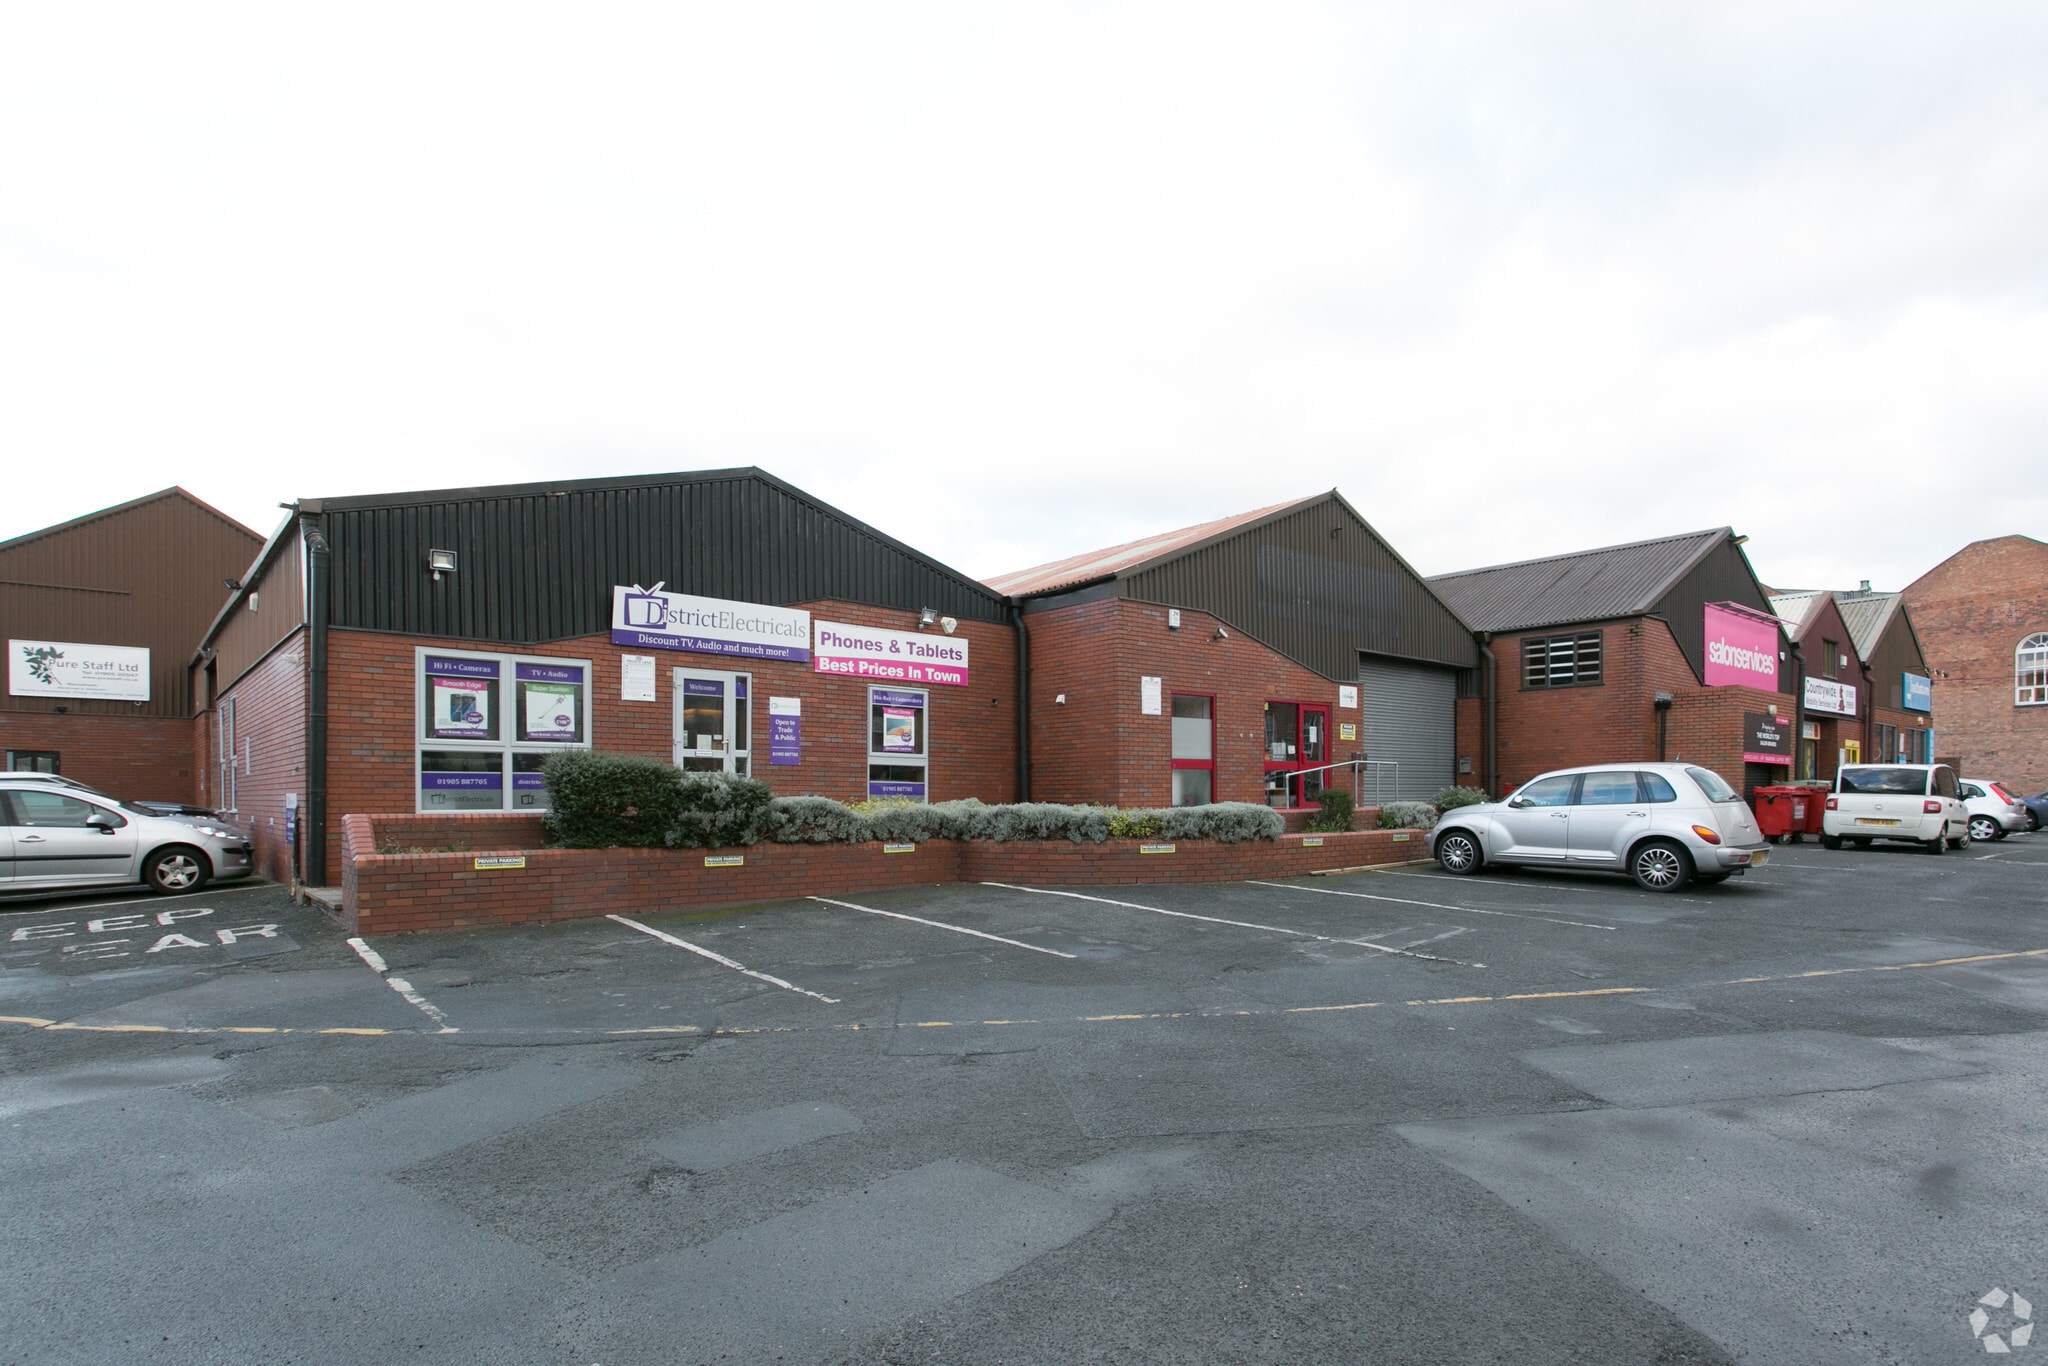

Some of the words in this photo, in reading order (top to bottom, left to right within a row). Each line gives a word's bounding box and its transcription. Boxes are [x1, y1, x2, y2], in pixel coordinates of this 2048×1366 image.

[645, 600, 807, 638] DistrictElectricals
[638, 634, 679, 648] Discount
[681, 638, 694, 649] TV,
[696, 640, 722, 651] Audio
[723, 643, 740, 653] and
[741, 645, 764, 656] much
[766, 647, 789, 658] more!
[820, 631, 883, 652] Phones
[888, 639, 900, 654] &
[906, 641, 963, 661] Tablets
[1709, 637, 1774, 675] salonservices
[48, 659, 79, 669] Pure
[83, 661, 114, 671] Staff
[118, 663, 139, 672] Ltd
[458, 664, 491, 673] Cameras
[819, 657, 855, 673] Best
[858, 661, 904, 678] Prices
[908, 665, 922, 679] In
[925, 667, 961, 683] Town
[689, 683, 717, 692] Welcome
[895, 696, 922, 704] Camcorders
[1806, 679, 1837, 698] Countrywide
[10, 908, 215, 942] EEP
[60, 924, 280, 961] EAR
